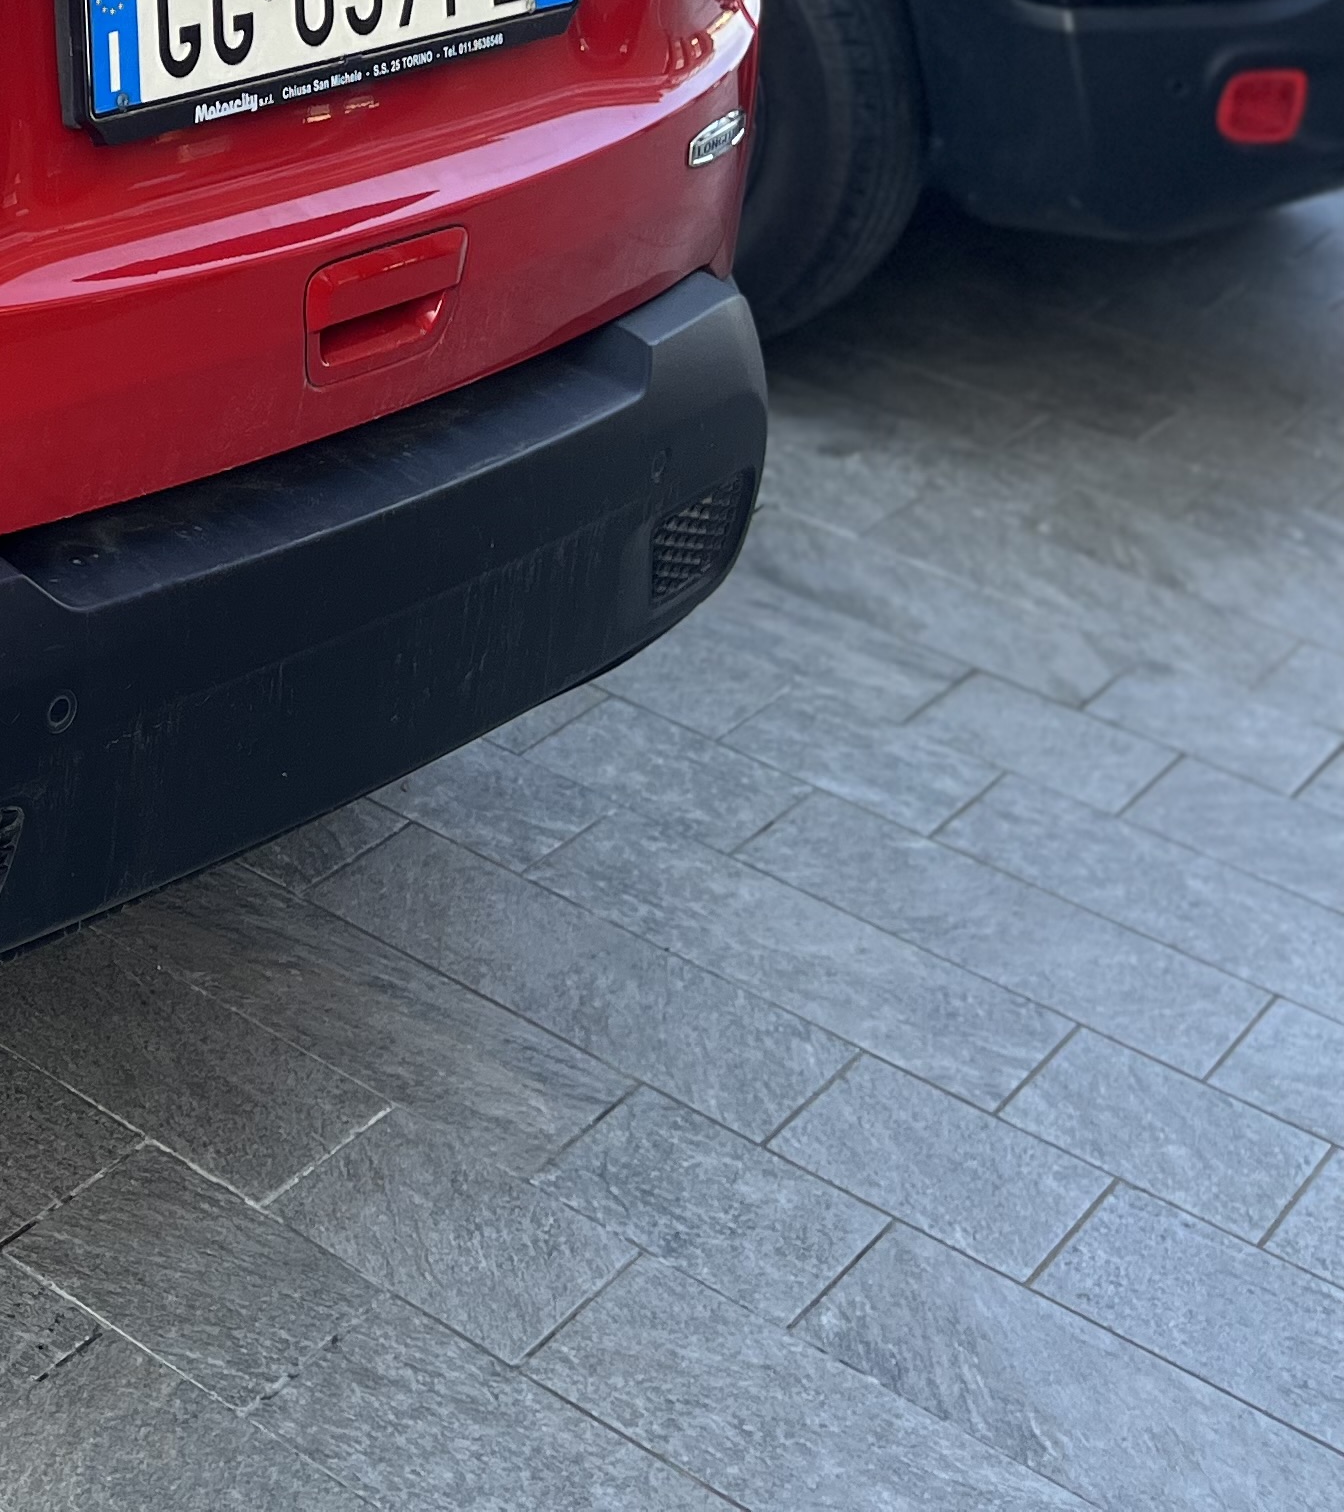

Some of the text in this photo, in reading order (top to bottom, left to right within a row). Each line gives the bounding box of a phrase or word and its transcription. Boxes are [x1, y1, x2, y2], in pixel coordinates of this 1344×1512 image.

[194, 92, 258, 124] Motorcity
[282, 85, 312, 100] Chiusa
[313, 78, 330, 92] San
[330, 70, 363, 88] Michele
[373, 62, 390, 76] S.S.
[391, 59, 401, 73] 25
[402, 50, 433, 70] TORINO
